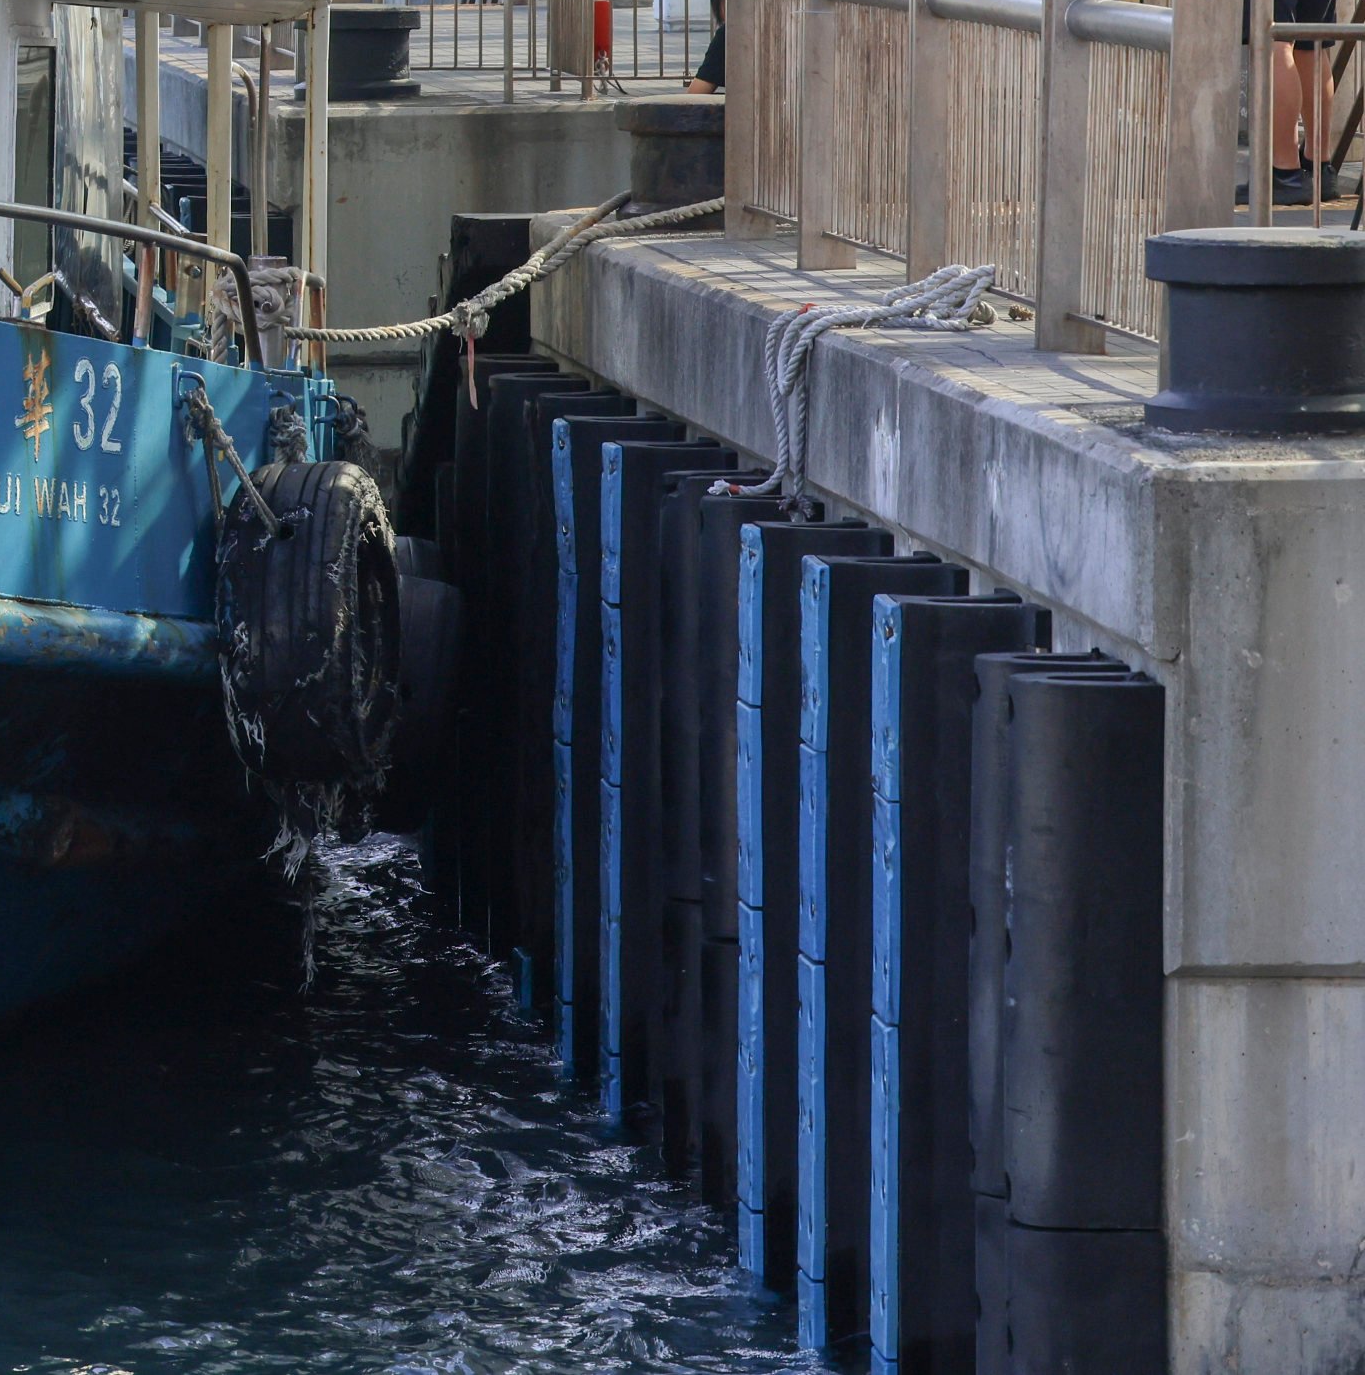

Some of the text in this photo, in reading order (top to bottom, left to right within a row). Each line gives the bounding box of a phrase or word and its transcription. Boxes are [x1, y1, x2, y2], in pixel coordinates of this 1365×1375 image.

[73, 356, 122, 454] 32
[34, 476, 87, 523] WAH
[99, 483, 120, 526] 32
